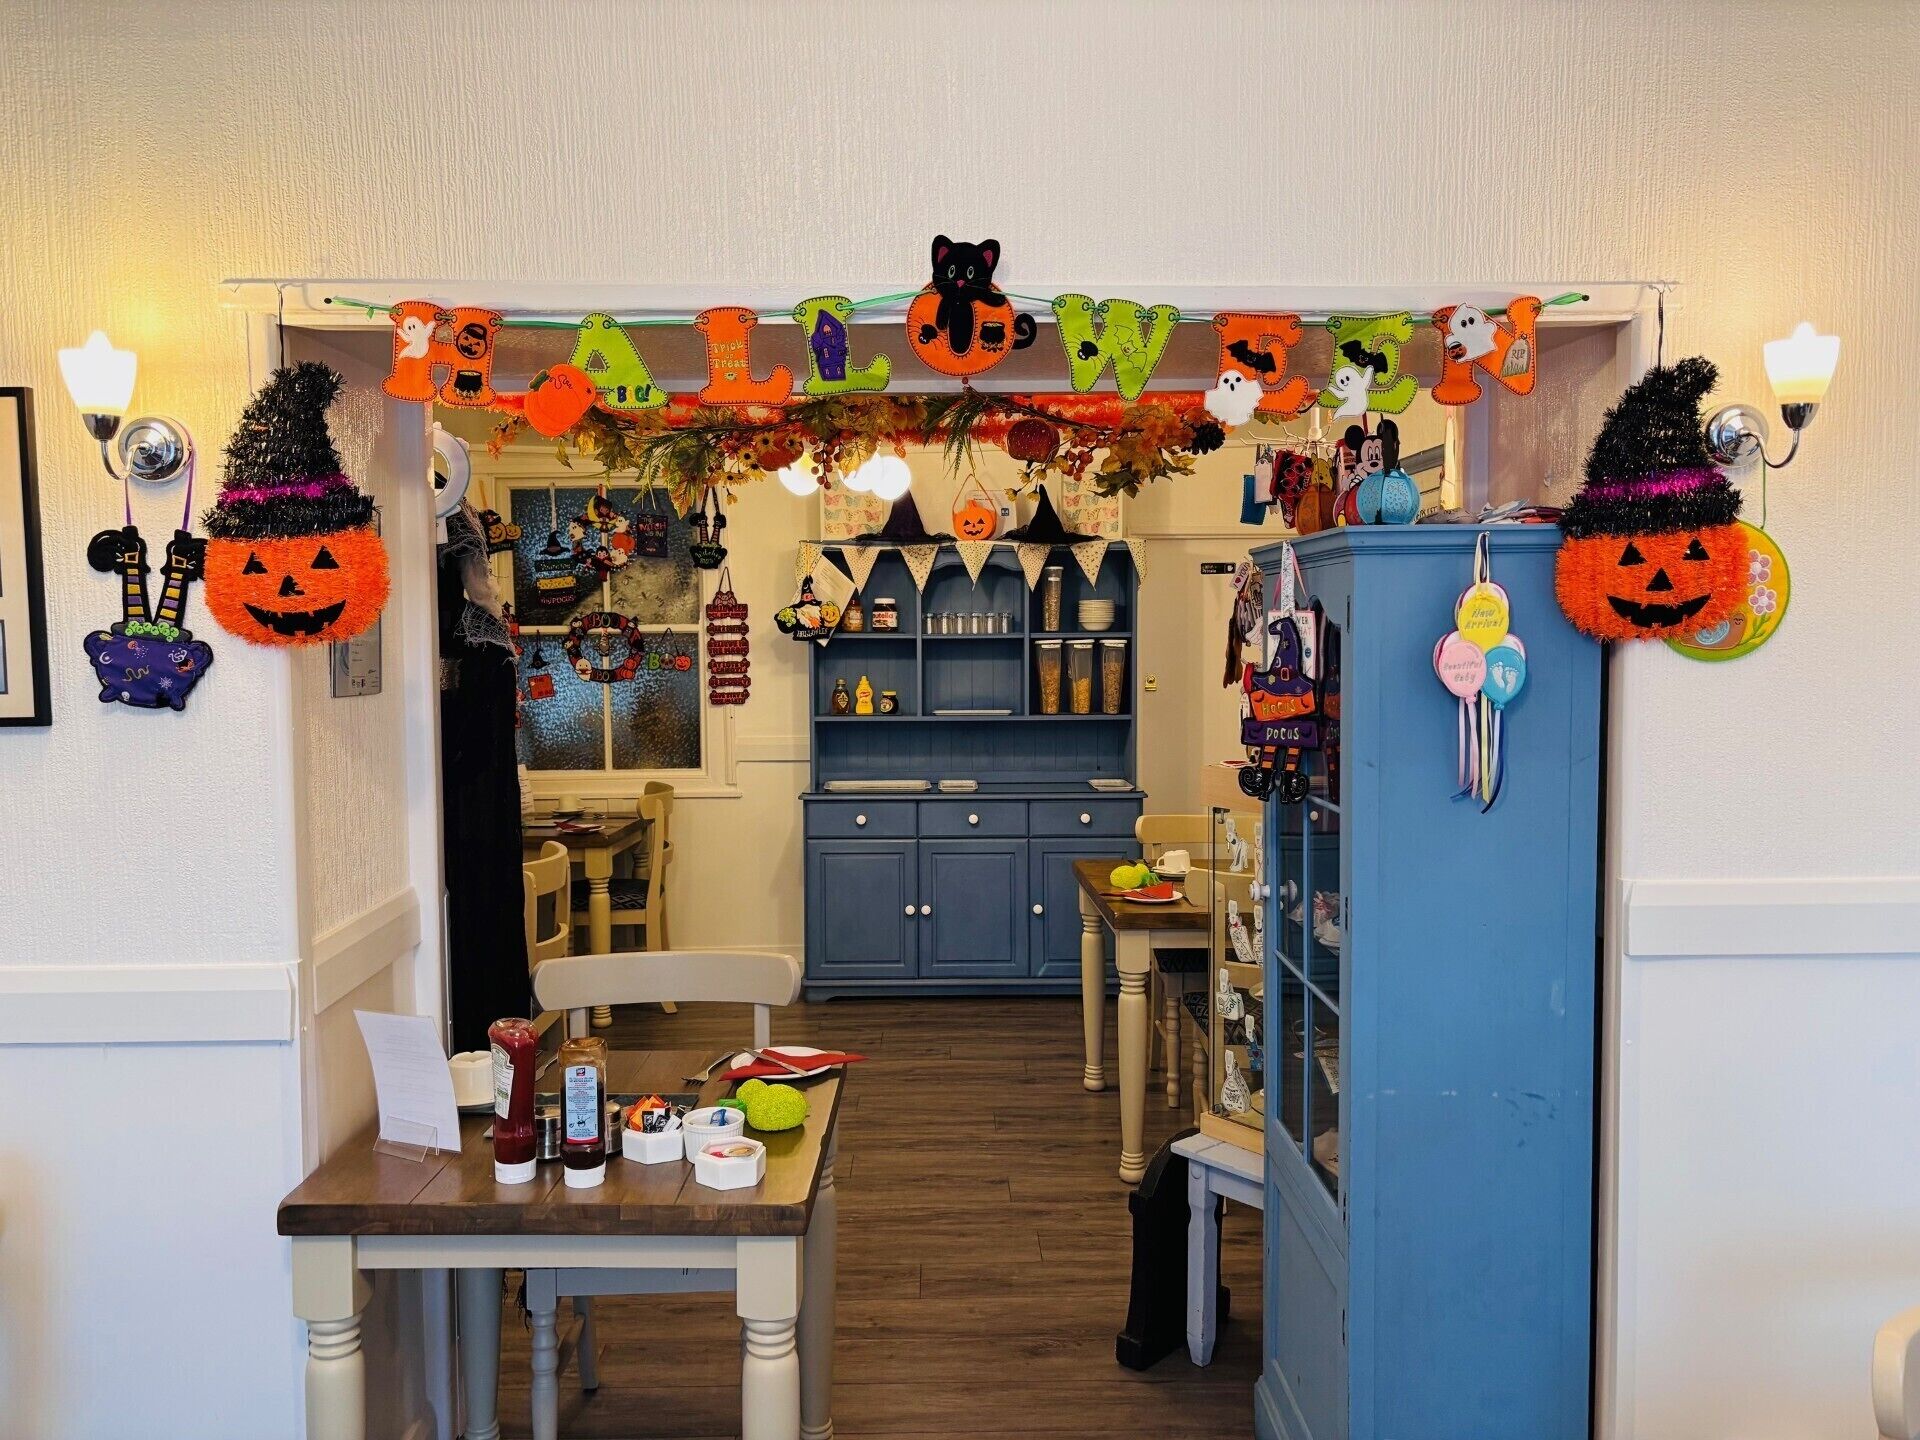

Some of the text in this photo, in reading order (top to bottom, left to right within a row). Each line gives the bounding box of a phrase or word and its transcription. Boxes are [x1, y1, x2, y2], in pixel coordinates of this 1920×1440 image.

[711, 340, 744, 353] Trick
[1511, 349, 1526, 360] RIP
[713, 358, 746, 369] Treat
[873, 611, 894, 620] nutella
[1472, 608, 1496, 618] New
[1265, 727, 1301, 740] POCUS
